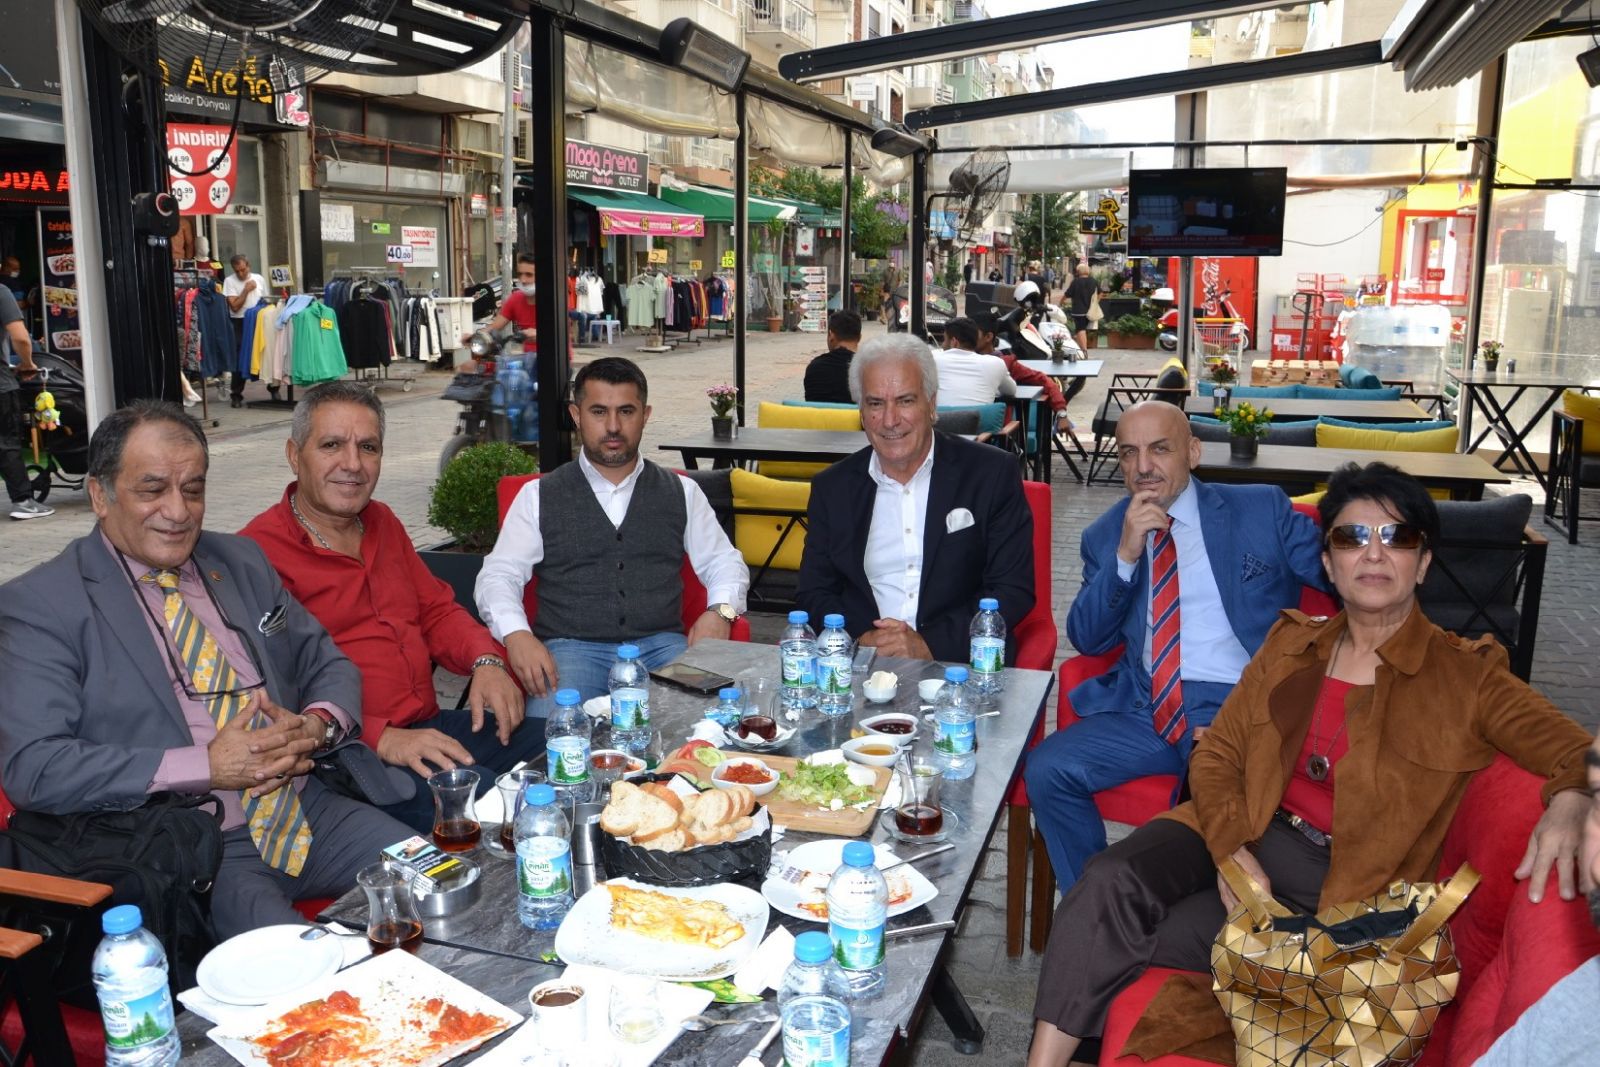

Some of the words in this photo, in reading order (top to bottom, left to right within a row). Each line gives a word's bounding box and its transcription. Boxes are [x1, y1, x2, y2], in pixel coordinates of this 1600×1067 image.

[565, 142, 600, 168] Moda
[602, 149, 638, 173] Arena
[618, 175, 640, 187] OUTLET
